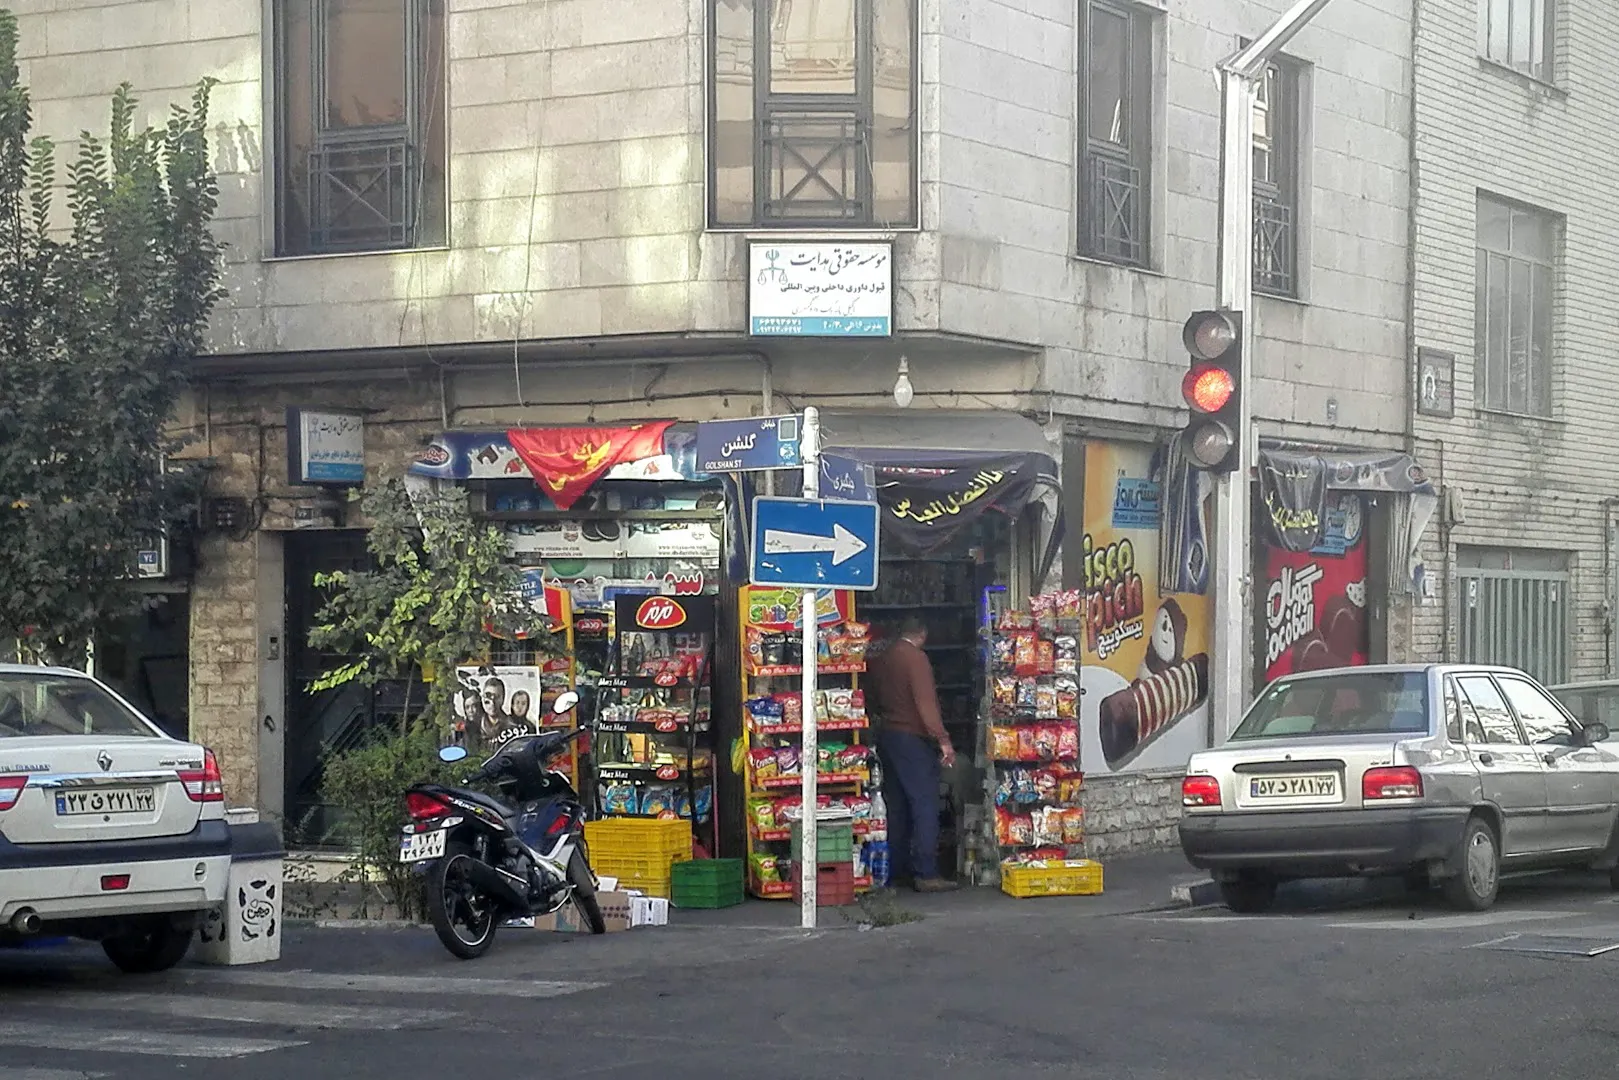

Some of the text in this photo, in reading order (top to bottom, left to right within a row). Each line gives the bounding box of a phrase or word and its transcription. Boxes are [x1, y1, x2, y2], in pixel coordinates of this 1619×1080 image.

[789, 251, 830, 272] هدایت
[828, 247, 860, 276] حقوقی
[868, 281, 886, 294] قبول
[721, 433, 757, 457] گلشن
[891, 498, 947, 526] العباس
[1083, 533, 1134, 589] isco
[1097, 620, 1144, 660] بیسکوپیچ
[1266, 603, 1314, 669] ocoball
[1259, 780, 1275, 794] ۵۷
[1290, 779, 1314, 794] ۲۸۱
[1317, 781, 1333, 794] ۷۷
[68, 792, 152, 811] ۲۳ ق ۲۷۱ ۲۲
[404, 844, 442, 859] ۲۹۶۹۷
